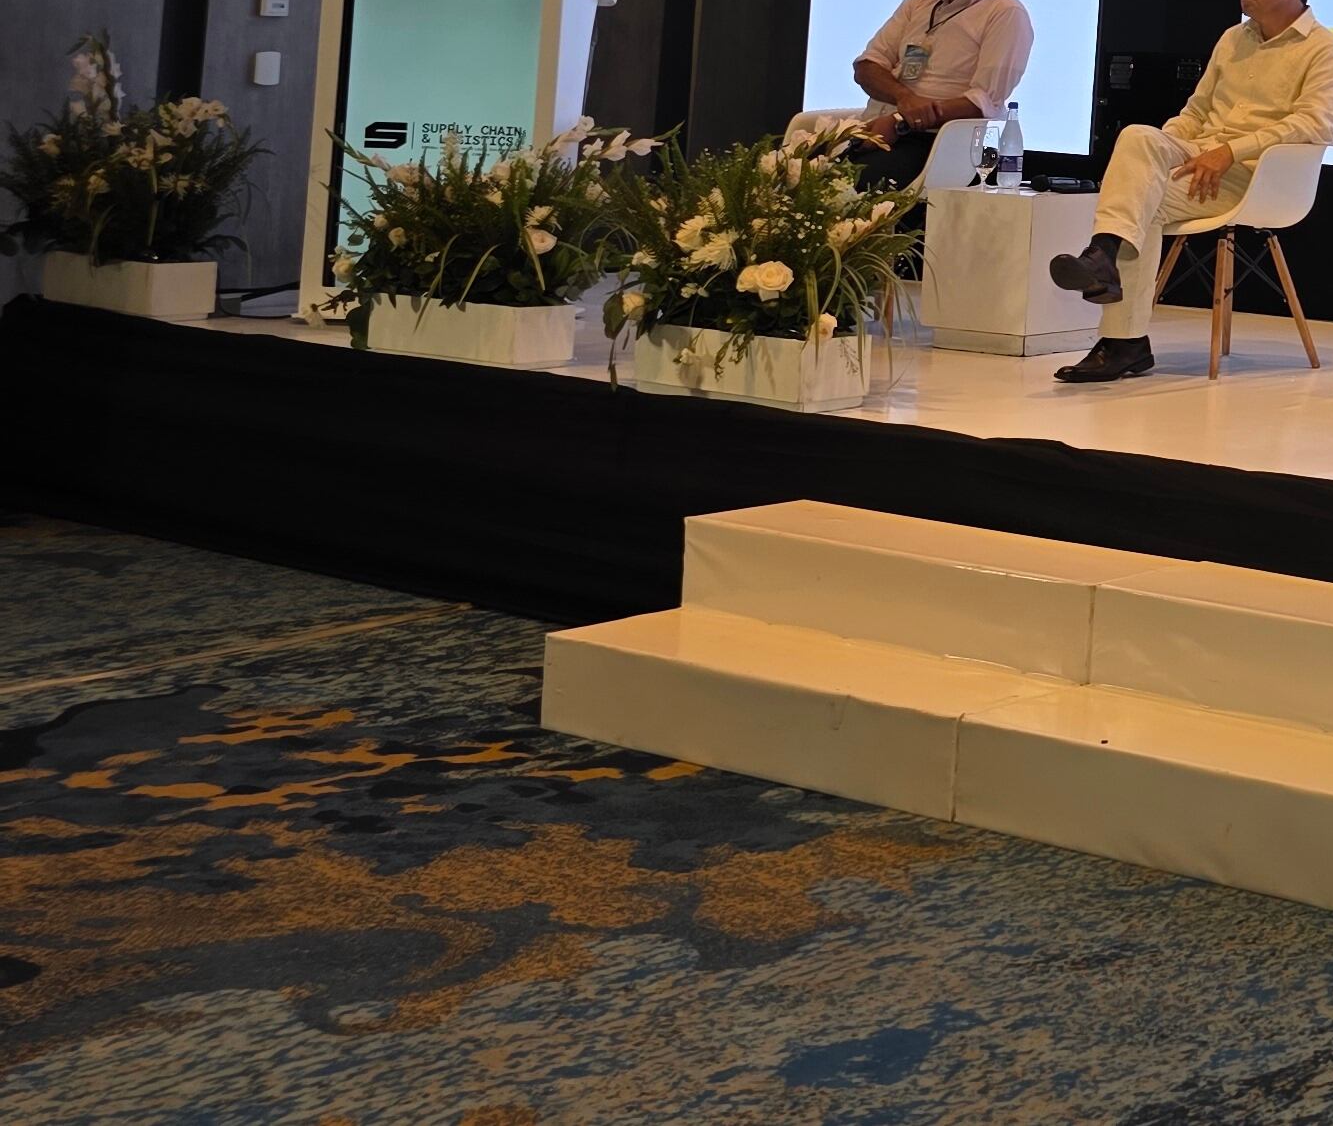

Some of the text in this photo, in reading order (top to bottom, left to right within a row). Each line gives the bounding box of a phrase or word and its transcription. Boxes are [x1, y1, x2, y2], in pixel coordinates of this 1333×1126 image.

[422, 123, 473, 134] SUPPLY
[421, 134, 514, 147] & LISTICS
